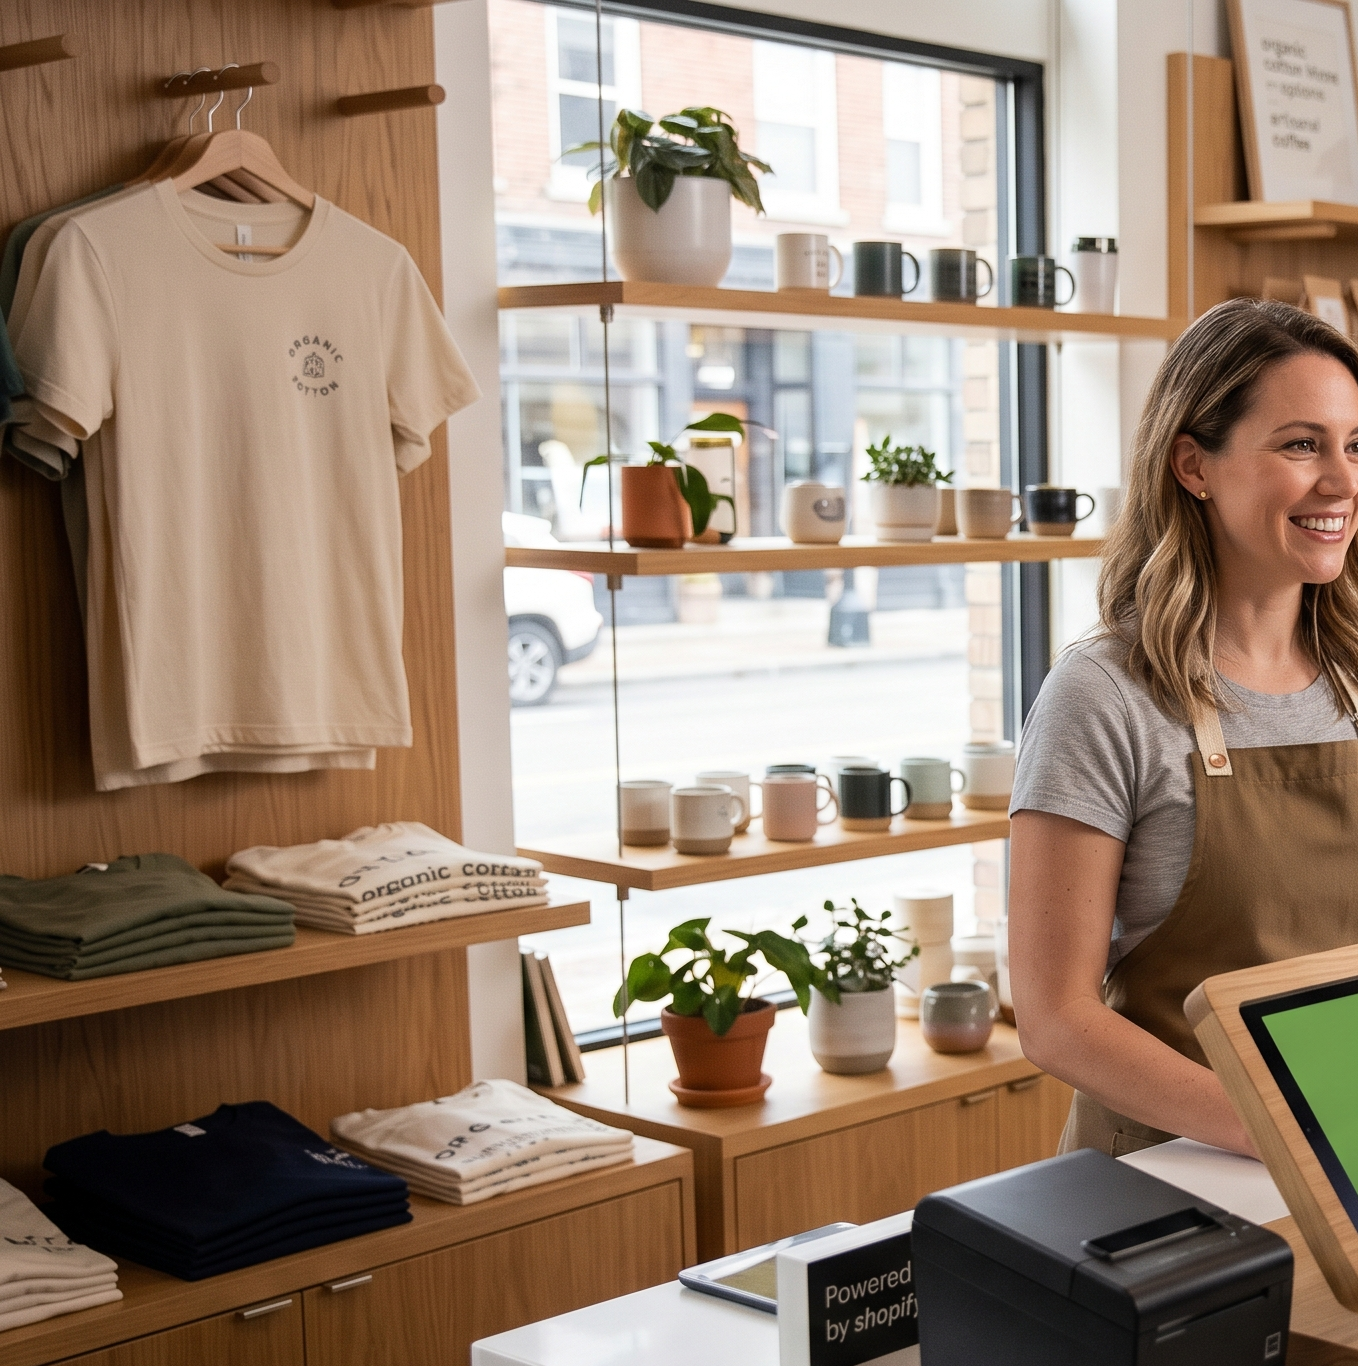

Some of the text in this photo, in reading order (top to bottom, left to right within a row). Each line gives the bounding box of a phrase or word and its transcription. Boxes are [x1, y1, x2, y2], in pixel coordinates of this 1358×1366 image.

[289, 335, 344, 363] ORGANIC
[825, 1260, 911, 1309] Powered
[826, 1319, 850, 1343] by
